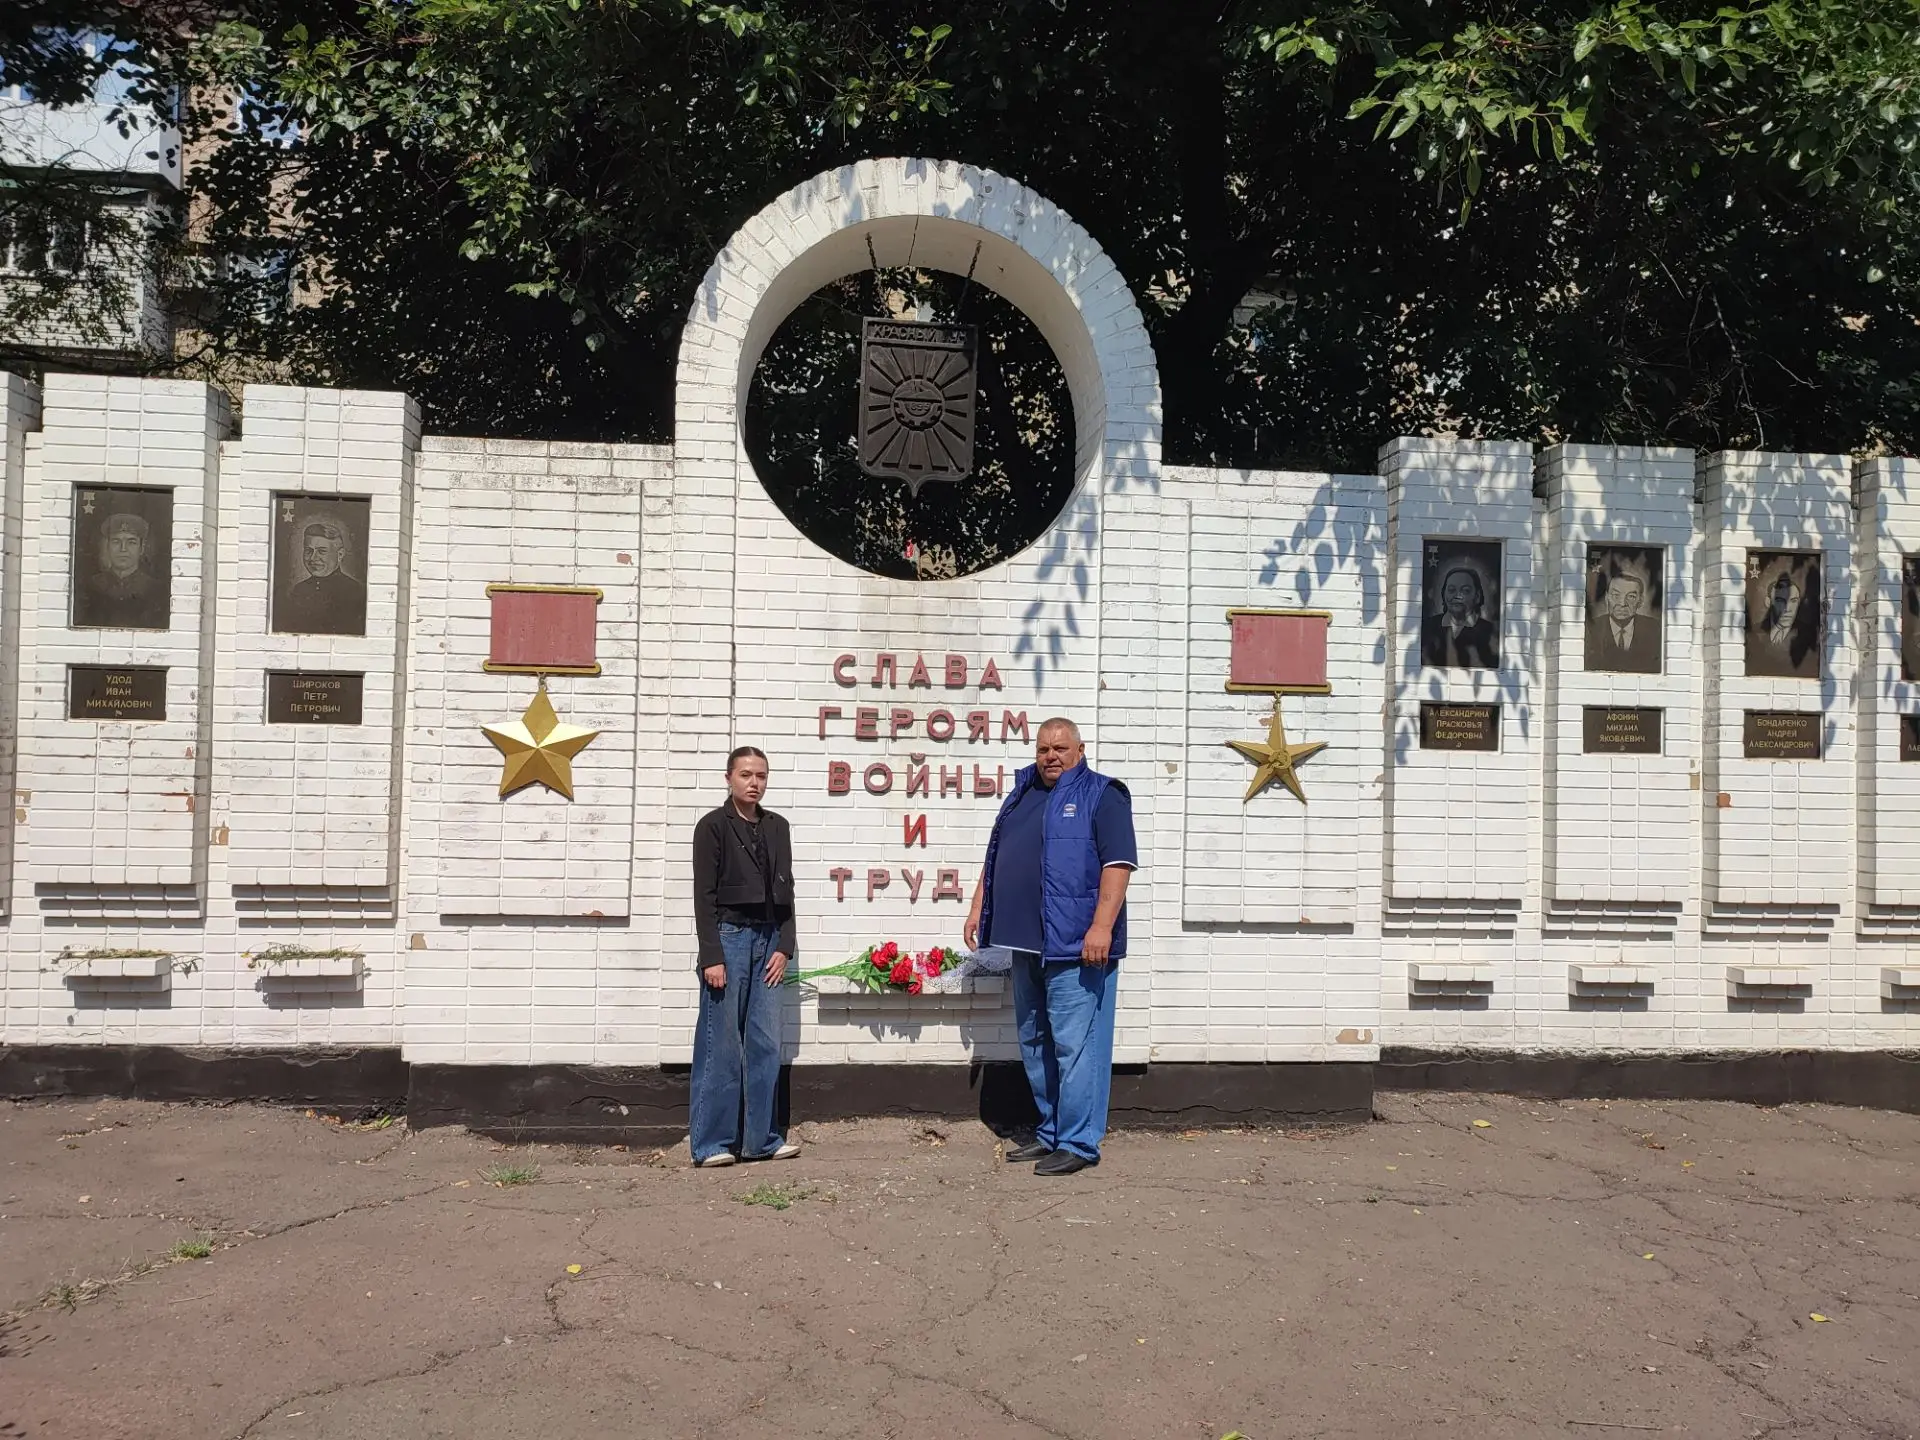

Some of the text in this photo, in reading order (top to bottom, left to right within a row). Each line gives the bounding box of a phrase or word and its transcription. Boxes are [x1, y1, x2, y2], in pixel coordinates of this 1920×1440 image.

[833, 653, 1002, 691] СЛАВА
[106, 675, 132, 684] УДОД
[293, 680, 341, 689] ШИРОКОВ
[106, 688, 132, 696] ИВАН
[303, 691, 328, 701] ПЕТР
[290, 703, 341, 713] ПЕТРОВИЧ
[1429, 708, 1490, 718] АЛЕКСАНДРИНА
[1606, 713, 1639, 721] АФОНИН
[819, 706, 1030, 745] ГЕРОЯМ
[1436, 720, 1483, 729] ПРАСКОВЬЯ
[1757, 718, 1807, 727] БОНДАРЕНКО
[1606, 724, 1639, 732] МИХАИЛ
[1435, 730, 1484, 740] ФЕДОРОВНА
[1599, 734, 1646, 743] ЯКОВЛЕВИЧ
[1748, 740, 1814, 749] АЛЕКСАНДРОВИЧ
[828, 752, 1004, 799] ВОЙНЫ
[903, 813, 927, 848] И
[829, 867, 964, 904] ТРУД
